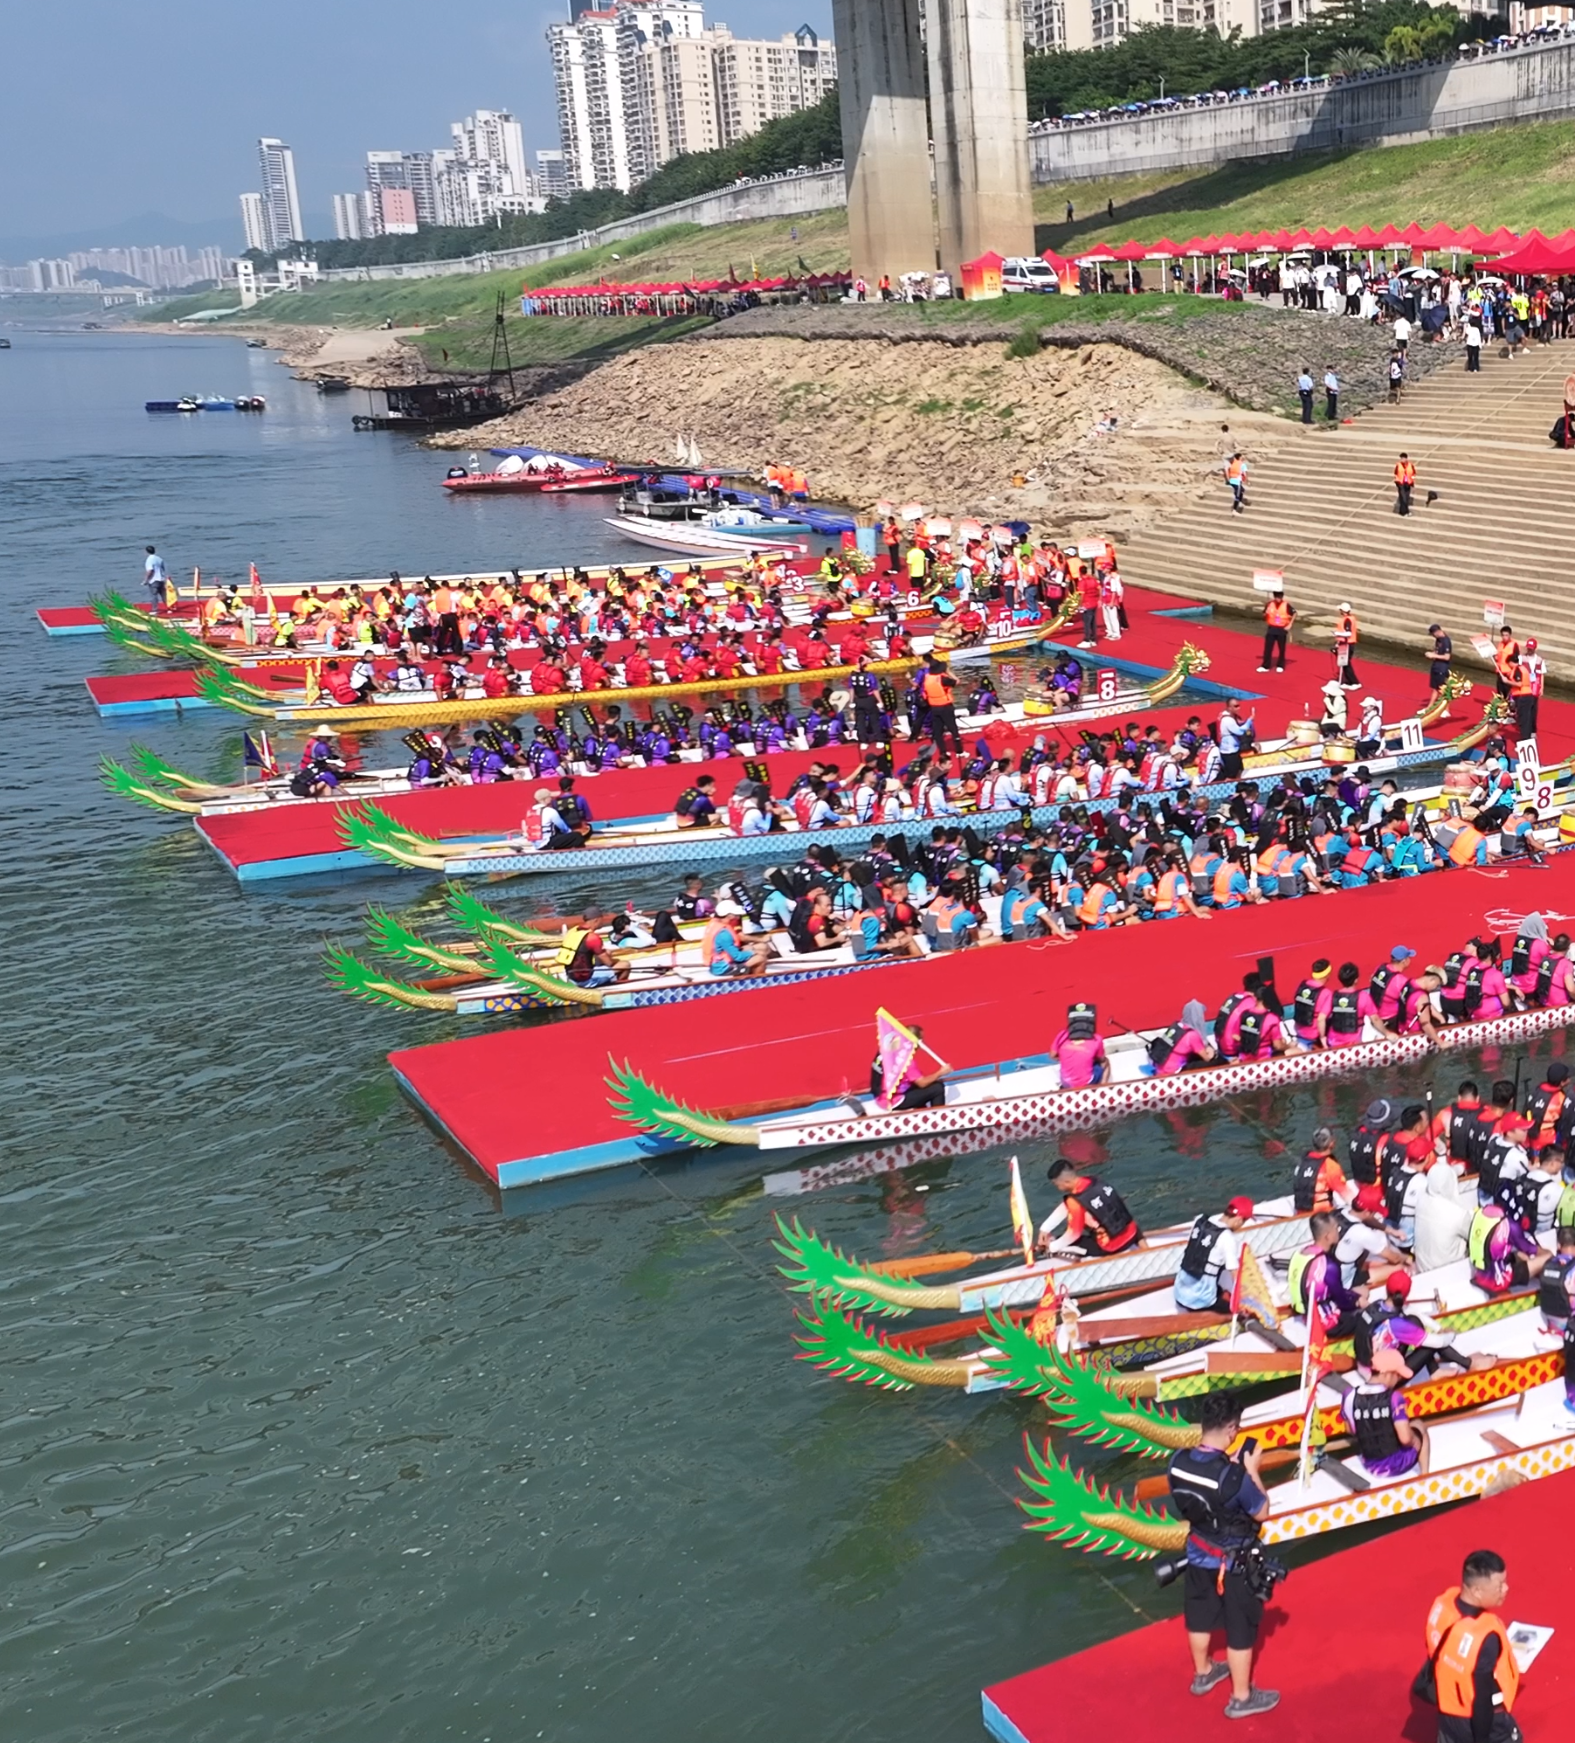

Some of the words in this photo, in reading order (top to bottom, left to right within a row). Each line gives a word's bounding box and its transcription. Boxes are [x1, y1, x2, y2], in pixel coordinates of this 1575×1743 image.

[792, 576, 804, 591] 3
[907, 594, 919, 607] 6
[996, 620, 1011, 636] 10
[1100, 680, 1115, 700] 8
[1404, 724, 1421, 746] 11
[1520, 745, 1537, 763] 10
[1522, 768, 1536, 791] 9
[1537, 786, 1551, 809] 8
